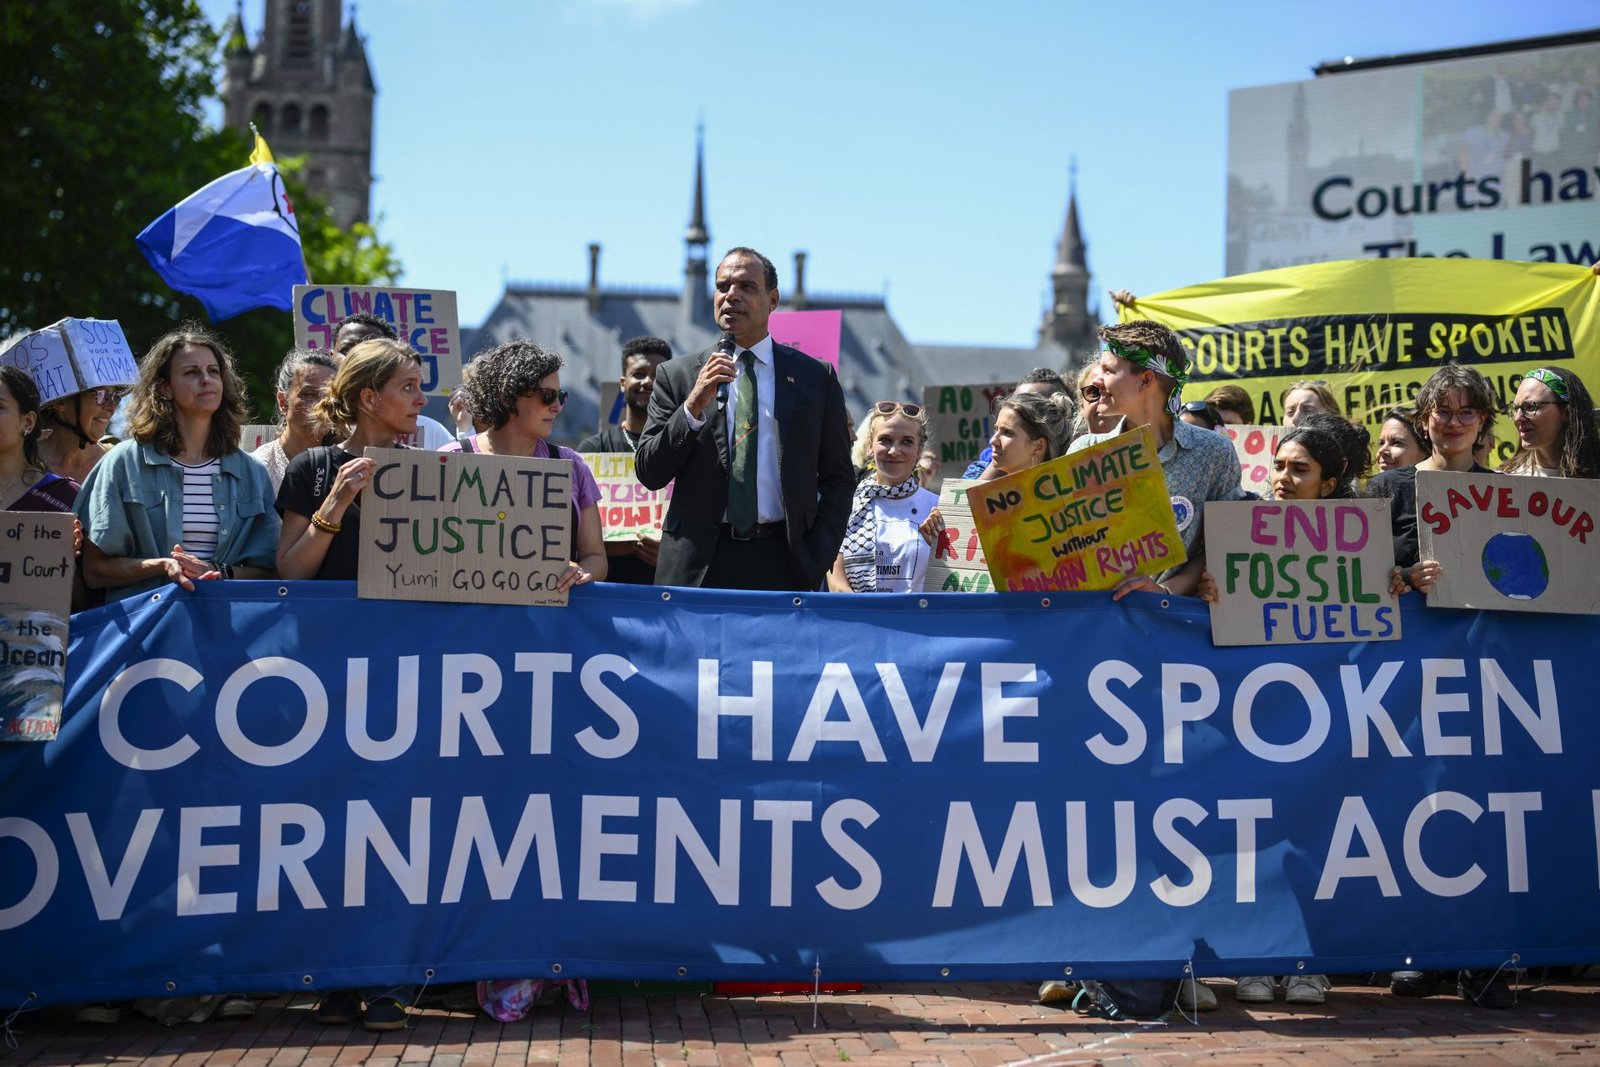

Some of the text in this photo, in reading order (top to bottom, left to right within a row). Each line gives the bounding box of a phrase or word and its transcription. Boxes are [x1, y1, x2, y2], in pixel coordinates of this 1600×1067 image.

[1312, 170, 1502, 222] Courts
[15, 334, 49, 370] OS
[80, 320, 121, 345] SOS
[1324, 322, 1414, 365] HAVE
[1425, 316, 1567, 359] SPOKEN
[986, 443, 1150, 514] NO CLIMATE
[7, 522, 62, 541] of the
[1023, 488, 1124, 543] JUSTICE
[1251, 504, 1370, 552] END
[1421, 484, 1594, 545] SAVE OUR
[23, 556, 69, 578] Court
[386, 563, 560, 592] Yumi GO GO GO
[876, 565, 901, 575] TIMIST
[16, 620, 52, 636] the
[1263, 601, 1394, 642] FUELS
[99, 652, 1564, 771] COURTS HAVE SPOKEN
[931, 797, 1273, 909] MUST
[1313, 790, 1543, 900] ACT
